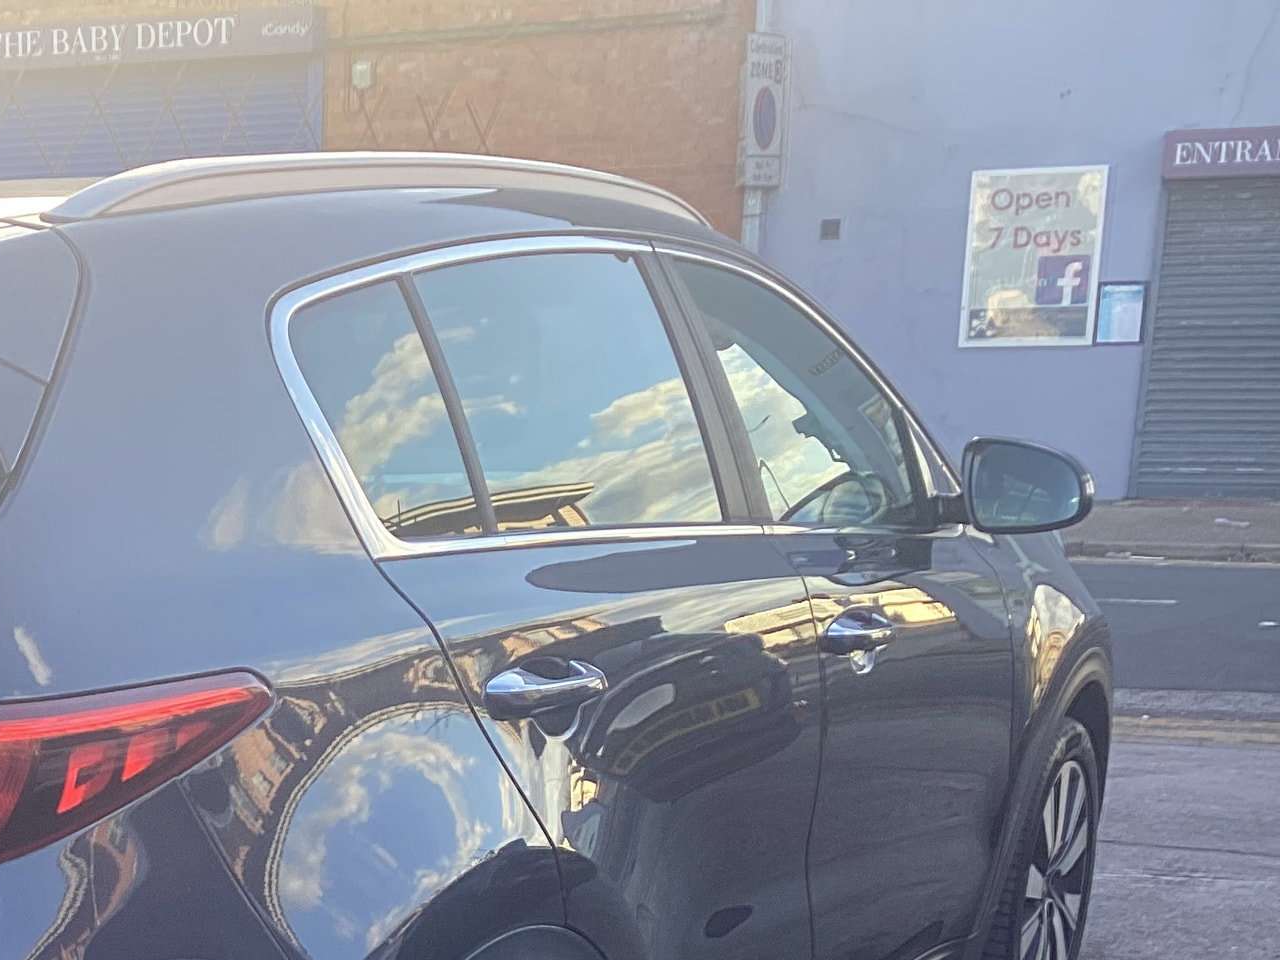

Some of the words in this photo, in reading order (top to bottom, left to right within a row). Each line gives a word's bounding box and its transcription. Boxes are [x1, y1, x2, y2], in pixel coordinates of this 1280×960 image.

[51, 24, 126, 55] BABY
[136, 15, 236, 50] DEPOT
[1174, 138, 1280, 165] ENTRA
[990, 187, 1072, 216] Open
[989, 226, 1004, 249] 7
[1013, 225, 1082, 253] Days
